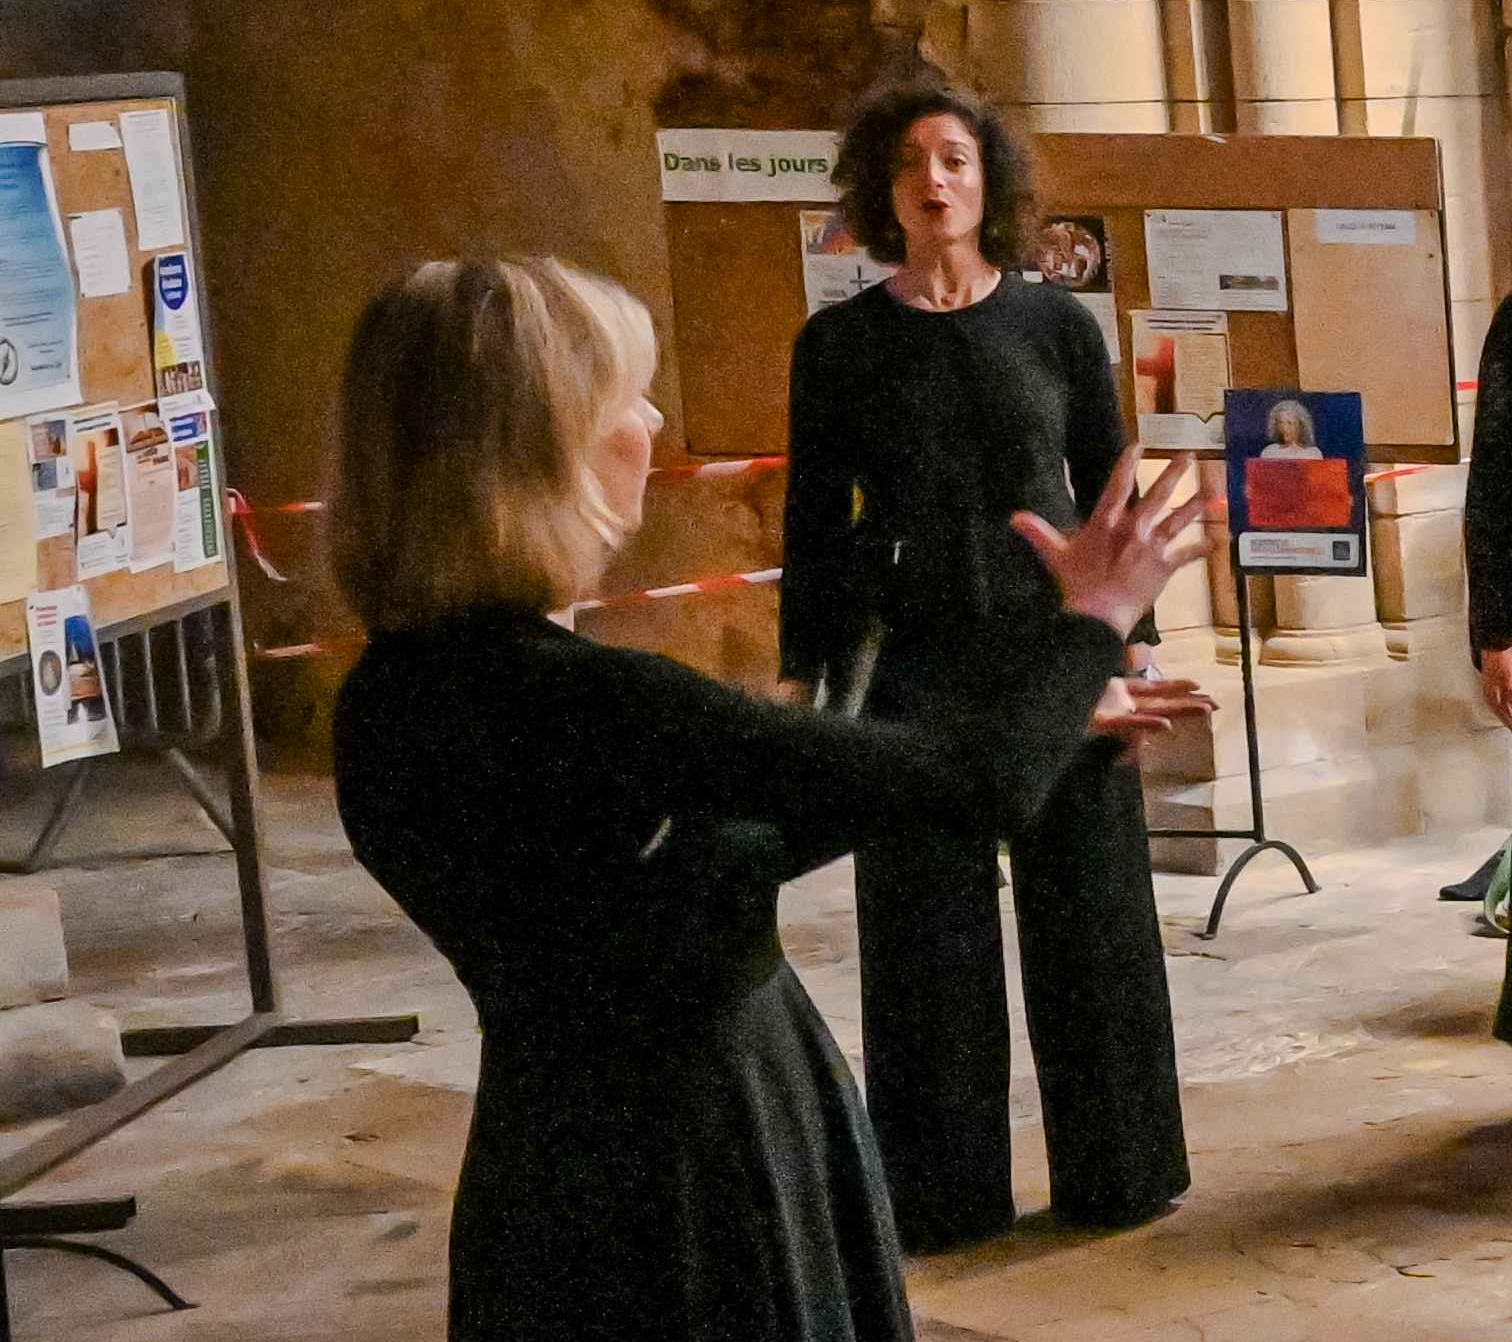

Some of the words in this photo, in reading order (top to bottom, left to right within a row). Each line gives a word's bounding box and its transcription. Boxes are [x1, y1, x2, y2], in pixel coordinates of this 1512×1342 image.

[664, 152, 721, 172] Dans
[728, 152, 761, 172] les
[768, 153, 828, 177] jours
